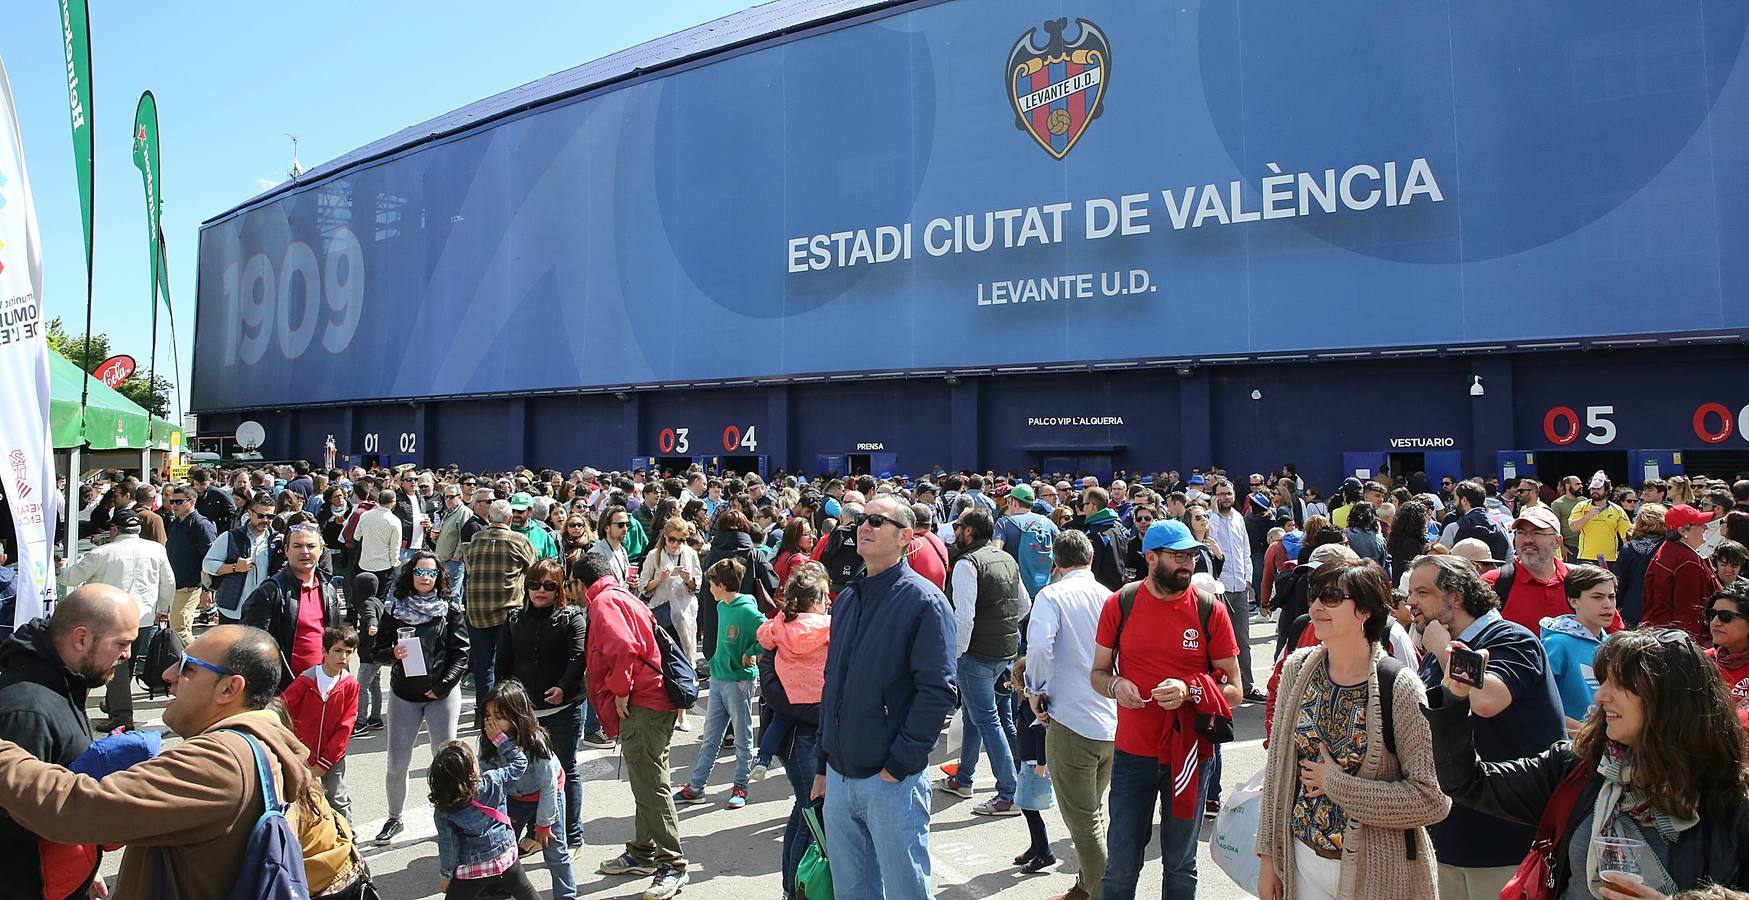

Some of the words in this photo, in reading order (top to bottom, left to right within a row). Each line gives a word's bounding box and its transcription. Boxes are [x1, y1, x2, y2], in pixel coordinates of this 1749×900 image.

[1025, 82, 1070, 109] LEVANTE
[1074, 72, 1095, 90] U.D.
[787, 222, 912, 273] ESTADI
[923, 202, 1072, 257] CIUTAT
[1085, 192, 1151, 240] DE
[1162, 158, 1444, 230] VALÈNCIA
[223, 227, 365, 367] 1909
[977, 273, 1093, 306] LEVANTE
[1101, 269, 1157, 298] U.D.
[1028, 417, 1057, 426] PALCO
[1057, 417, 1071, 426] VIP
[1543, 405, 1617, 445] 05
[364, 433, 379, 452] 01
[400, 432, 416, 452] 02
[659, 427, 689, 454] 03
[723, 425, 757, 452] 04
[857, 443, 884, 451] PRENSA
[1390, 437, 1455, 447] VESTUARIO
[1182, 640, 1199, 648] CAU
